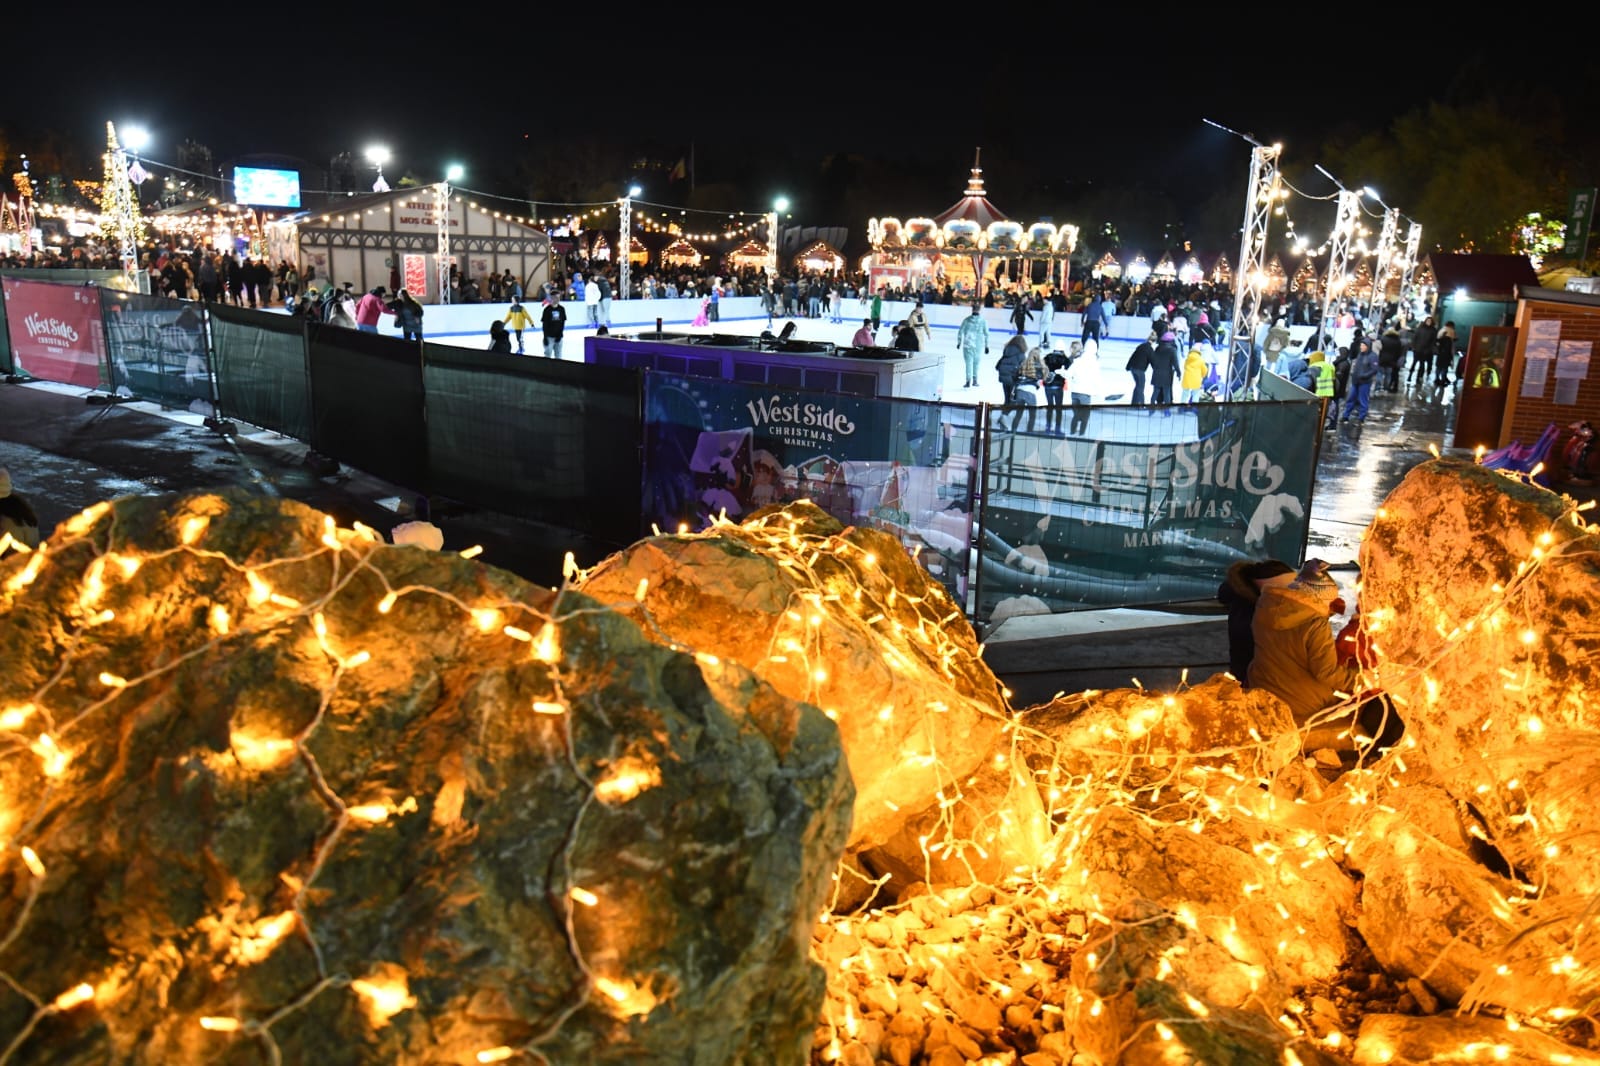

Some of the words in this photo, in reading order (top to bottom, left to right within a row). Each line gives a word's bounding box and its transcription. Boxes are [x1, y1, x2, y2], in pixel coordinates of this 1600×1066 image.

[24, 312, 51, 337] West
[49, 318, 79, 342] Side
[746, 395, 801, 426] West
[802, 403, 855, 435] Side
[769, 426, 833, 442] CHRISTMAS
[784, 438, 816, 448] MARKET
[1024, 430, 1166, 515] West
[1169, 437, 1285, 496] Side
[1083, 500, 1233, 527] CHRISTMAS
[1123, 528, 1195, 548] MARKET
